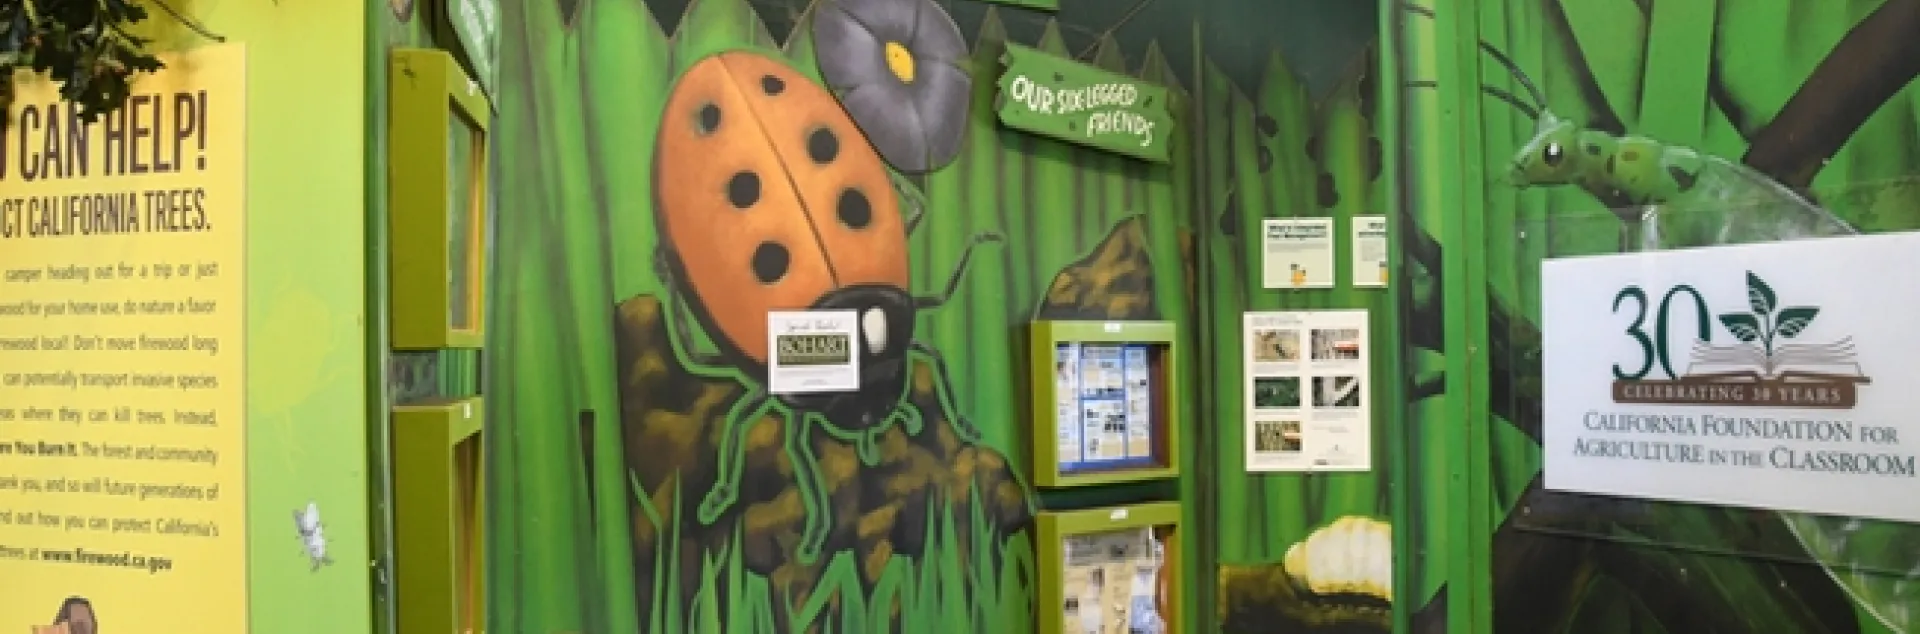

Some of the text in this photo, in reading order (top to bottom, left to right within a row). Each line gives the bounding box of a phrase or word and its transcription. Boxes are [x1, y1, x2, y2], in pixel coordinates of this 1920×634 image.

[1011, 75, 1055, 114] OUR
[1086, 83, 1138, 109] LEGGED
[20, 103, 89, 181] CAN
[104, 90, 208, 177] HELP!
[1087, 110, 1155, 147] FRIENDS
[28, 192, 140, 237] CALIFORNIA
[142, 187, 211, 234] TREES.
[6, 269, 41, 282] camper
[48, 264, 89, 283] heading
[95, 265, 113, 279] out
[118, 262, 133, 277] for
[153, 264, 172, 280] trip
[178, 265, 191, 277] or
[195, 263, 218, 280] just
[28, 300, 41, 315] for
[44, 303, 65, 317] your
[67, 300, 97, 315] home
[124, 299, 136, 315] do
[139, 301, 174, 315] nature
[188, 297, 216, 314] favor
[74, 336, 103, 350] Don't
[106, 338, 136, 350] move
[139, 333, 189, 350] firewood
[192, 335, 219, 356] long
[1612, 283, 1711, 381] 30
[24, 371, 77, 390] potentially
[80, 373, 128, 388] transport
[132, 373, 174, 387] invasive
[1622, 383, 1842, 404] CELEBRATING 30 YEARS
[22, 405, 53, 421] where
[59, 405, 82, 425] they
[89, 409, 107, 421] can
[115, 406, 130, 421] kill
[1583, 409, 1899, 444] CALIFORNIA FOUNDATION FOR
[15, 441, 36, 454] You
[38, 441, 63, 456] Burn
[82, 441, 100, 456] The
[103, 443, 132, 458] forest
[135, 444, 154, 459] and
[155, 446, 218, 465] community
[1574, 436, 1916, 478] AGRICULTURE IN THE CLASSROOM
[46, 477, 65, 492] and
[68, 480, 81, 492] so
[83, 477, 100, 492] will
[104, 477, 136, 495] future
[139, 483, 204, 501] generations
[207, 482, 219, 499] of
[17, 512, 33, 525] out
[38, 511, 59, 526] how
[64, 515, 85, 532] you
[88, 516, 107, 529] can
[112, 517, 151, 534] protect
[156, 518, 219, 537] California's
[29, 547, 39, 560] at
[41, 547, 172, 575] www.firewood.ca.gov
